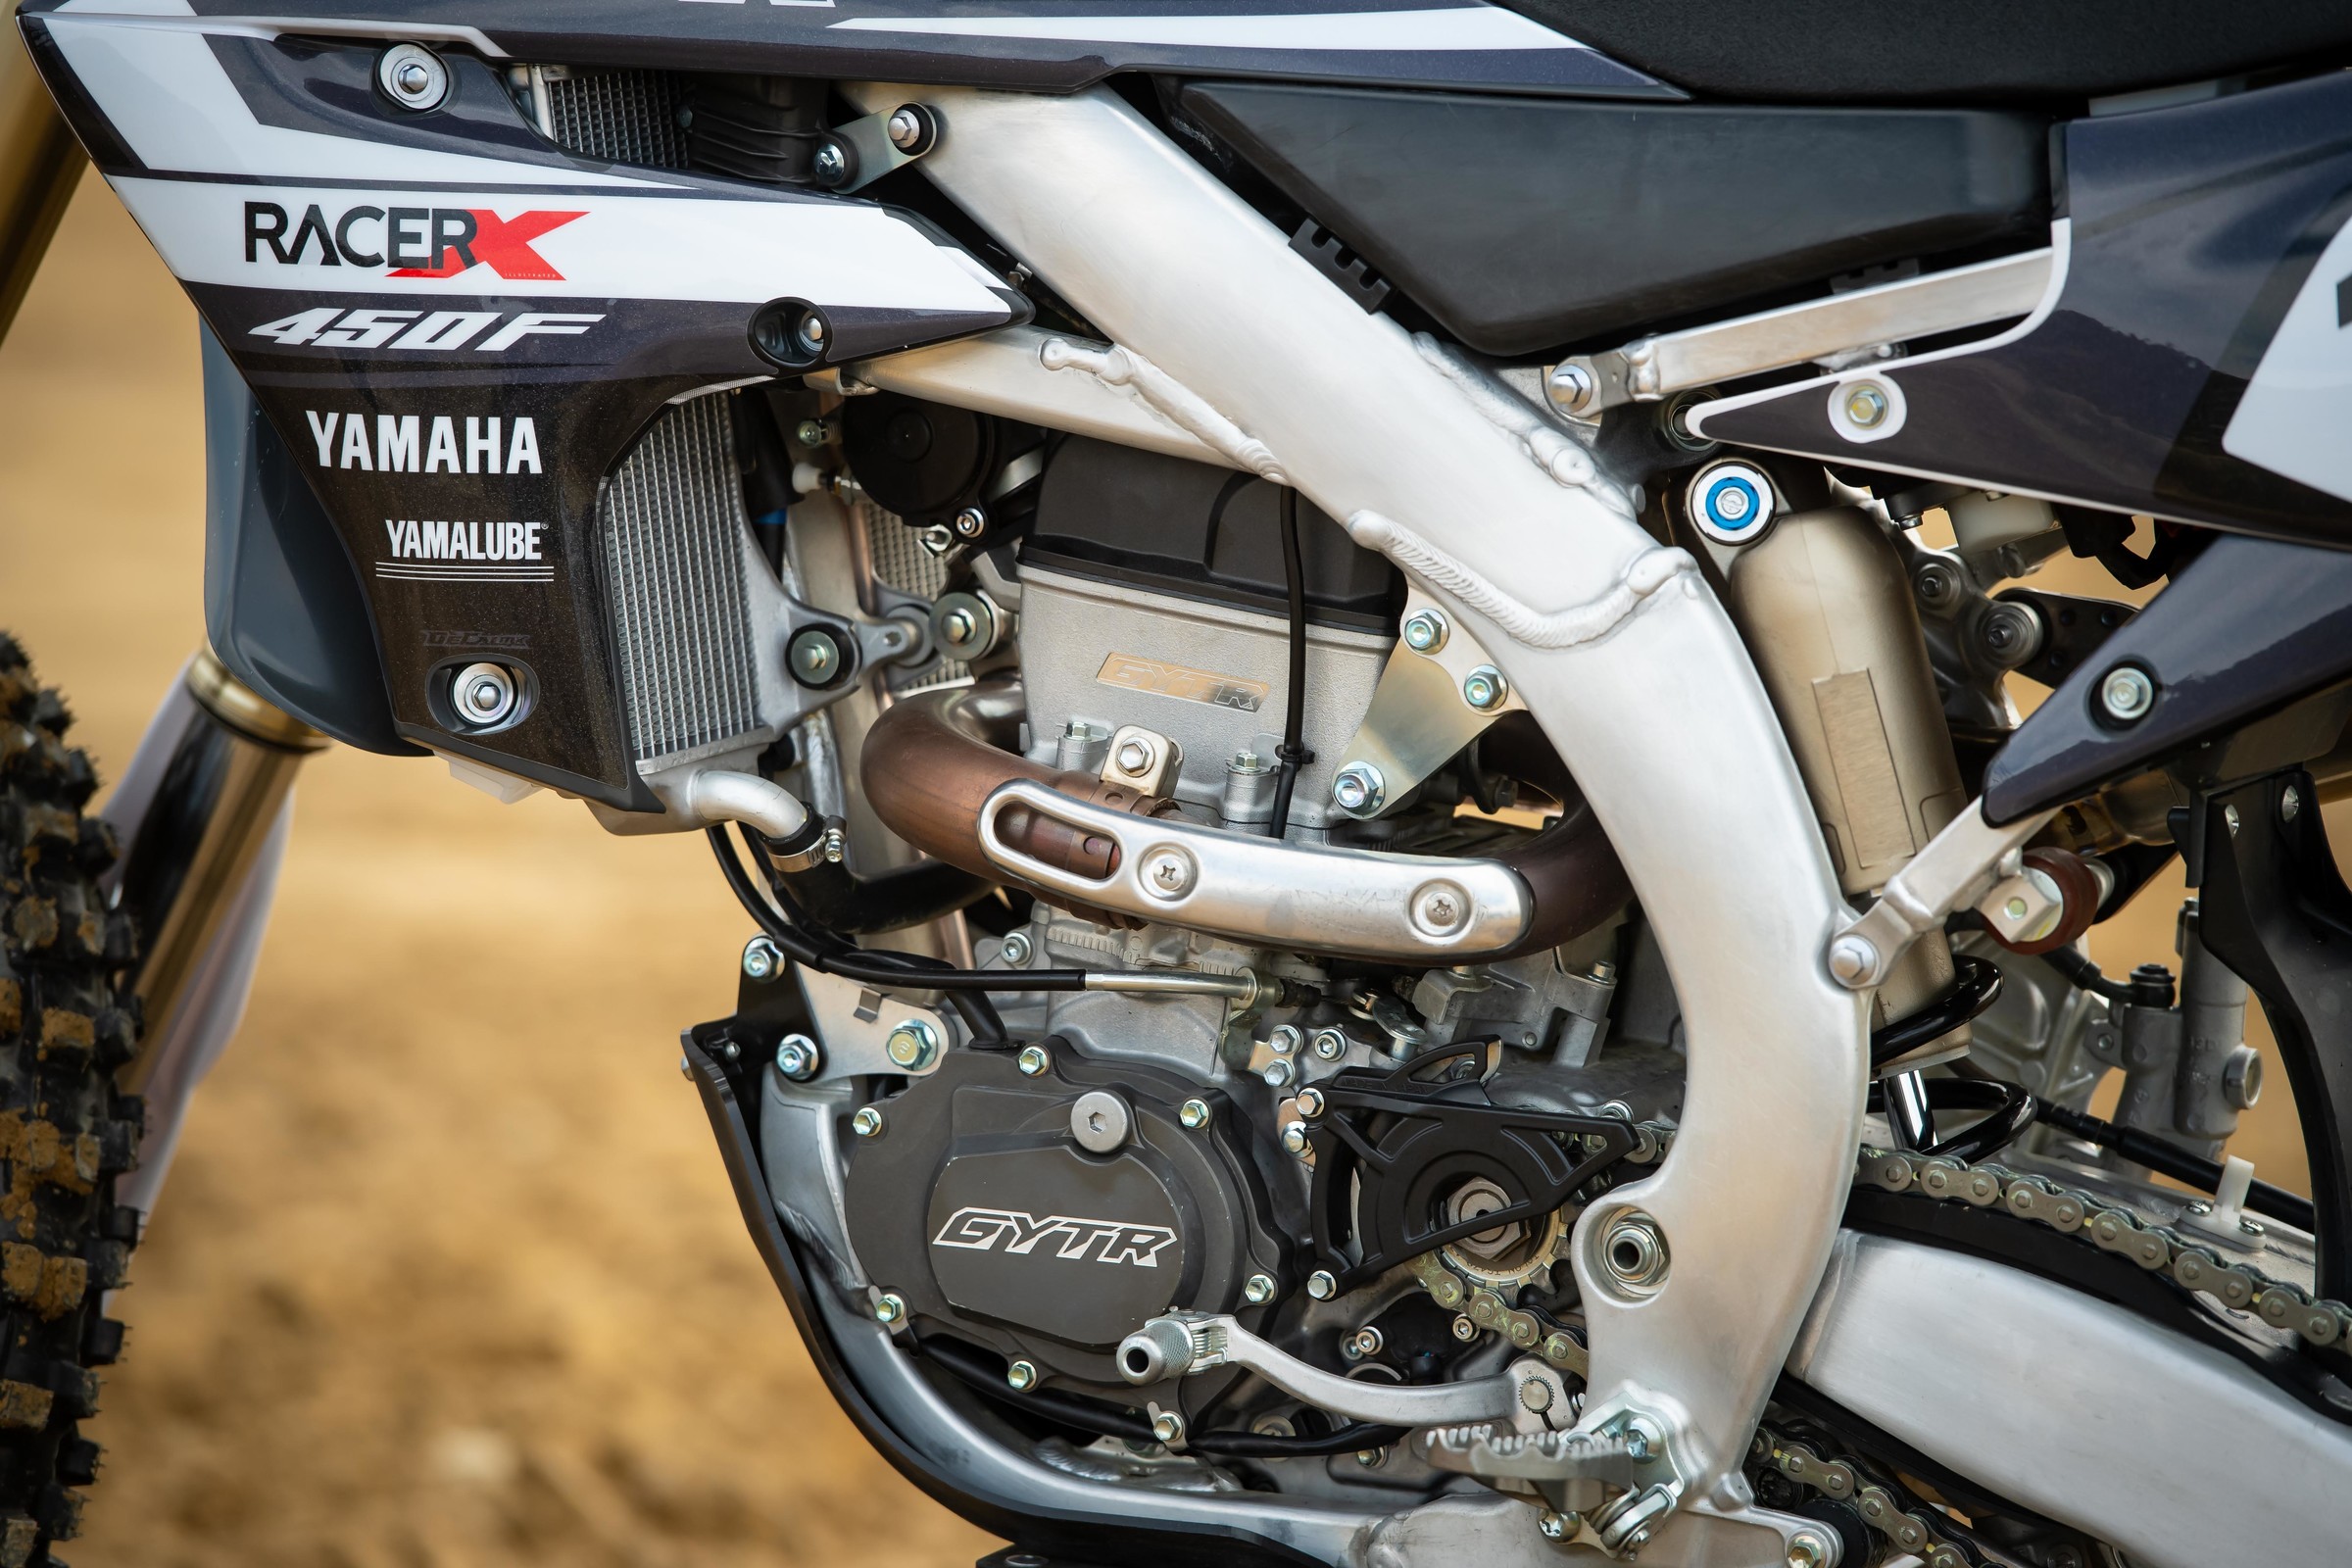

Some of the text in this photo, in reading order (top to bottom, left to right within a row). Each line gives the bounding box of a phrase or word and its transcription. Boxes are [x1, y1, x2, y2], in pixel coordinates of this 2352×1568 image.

[247, 307, 607, 352] 450F
[305, 410, 543, 474] YAMAHA
[1099, 657, 1264, 710] GYTR
[932, 1206, 1178, 1268] GYTR
